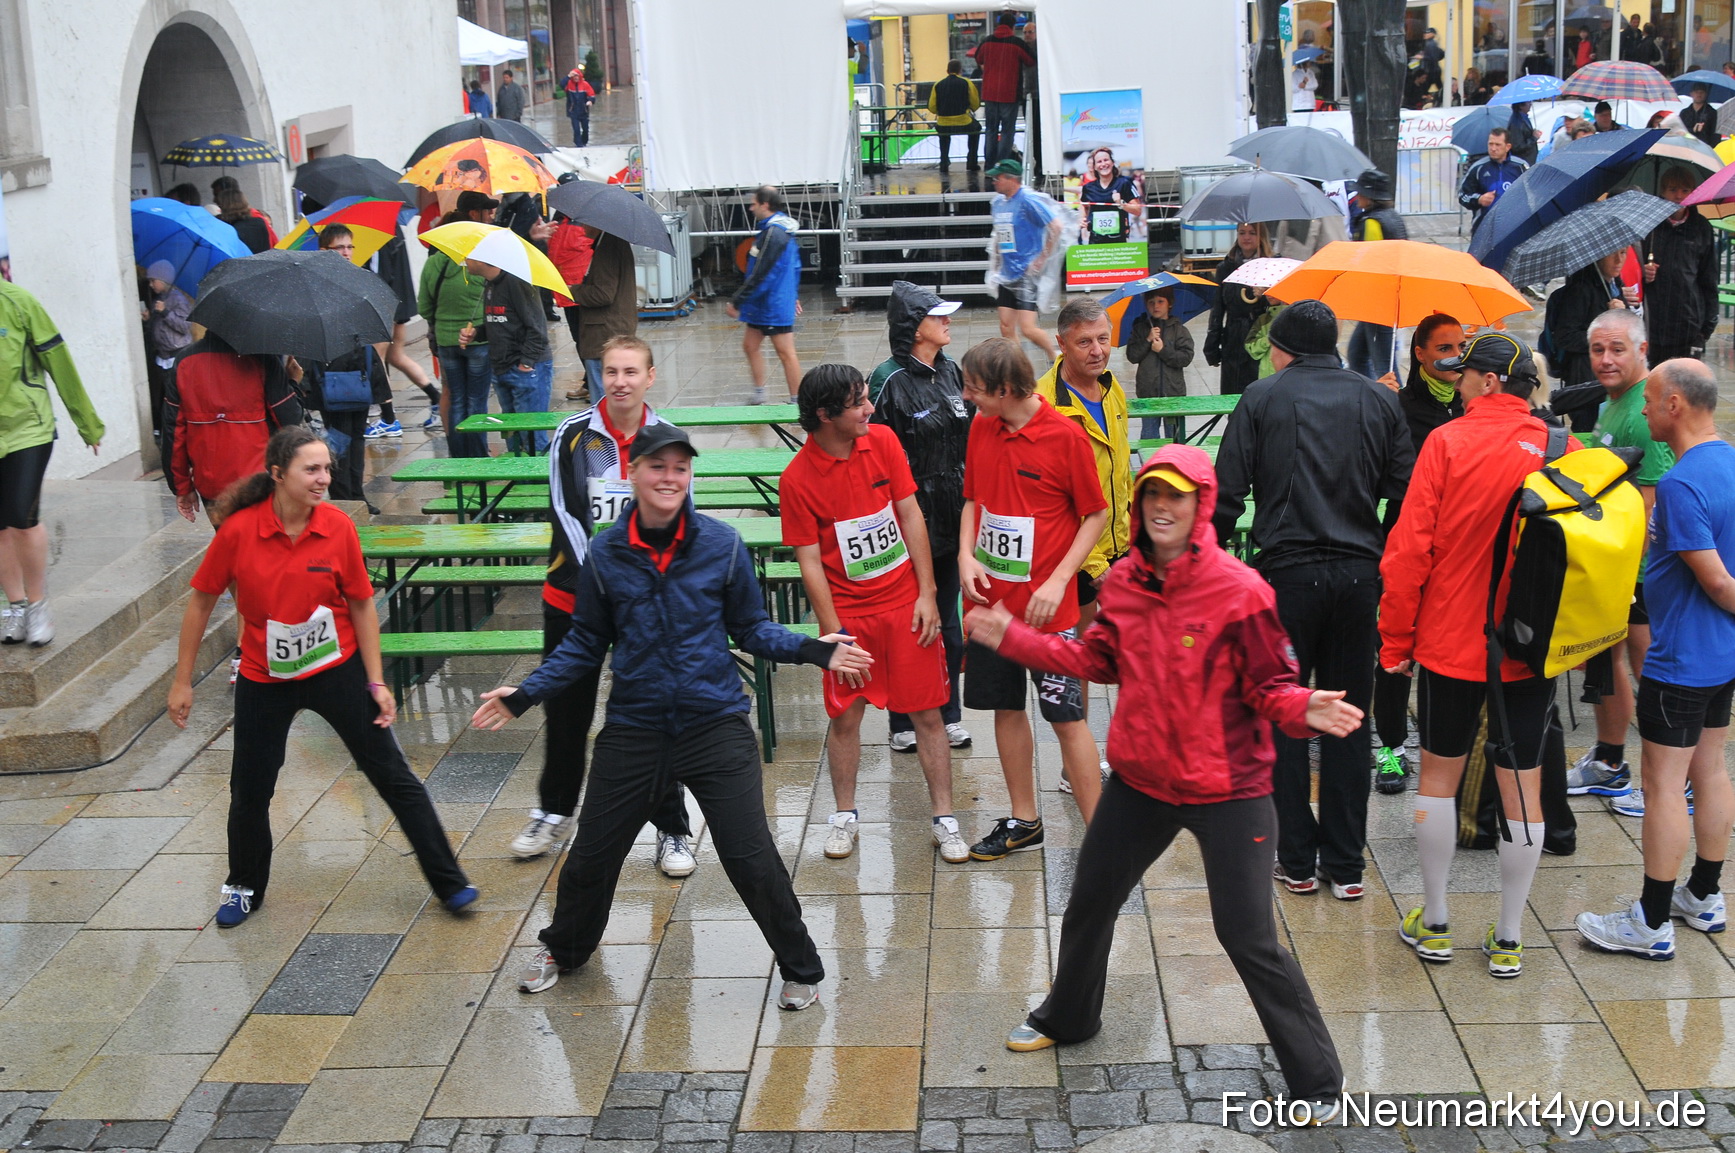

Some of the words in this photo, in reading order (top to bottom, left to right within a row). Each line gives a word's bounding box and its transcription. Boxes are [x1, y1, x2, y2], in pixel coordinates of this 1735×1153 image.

[1418, 117, 1455, 132] UNS
[1099, 219, 1113, 228] 352
[1071, 270, 1144, 278] www.metropolmarathon.de
[847, 520, 898, 560] 5159
[981, 525, 1023, 559] 5181
[863, 551, 896, 571] Benigno
[275, 621, 330, 660] 5182
